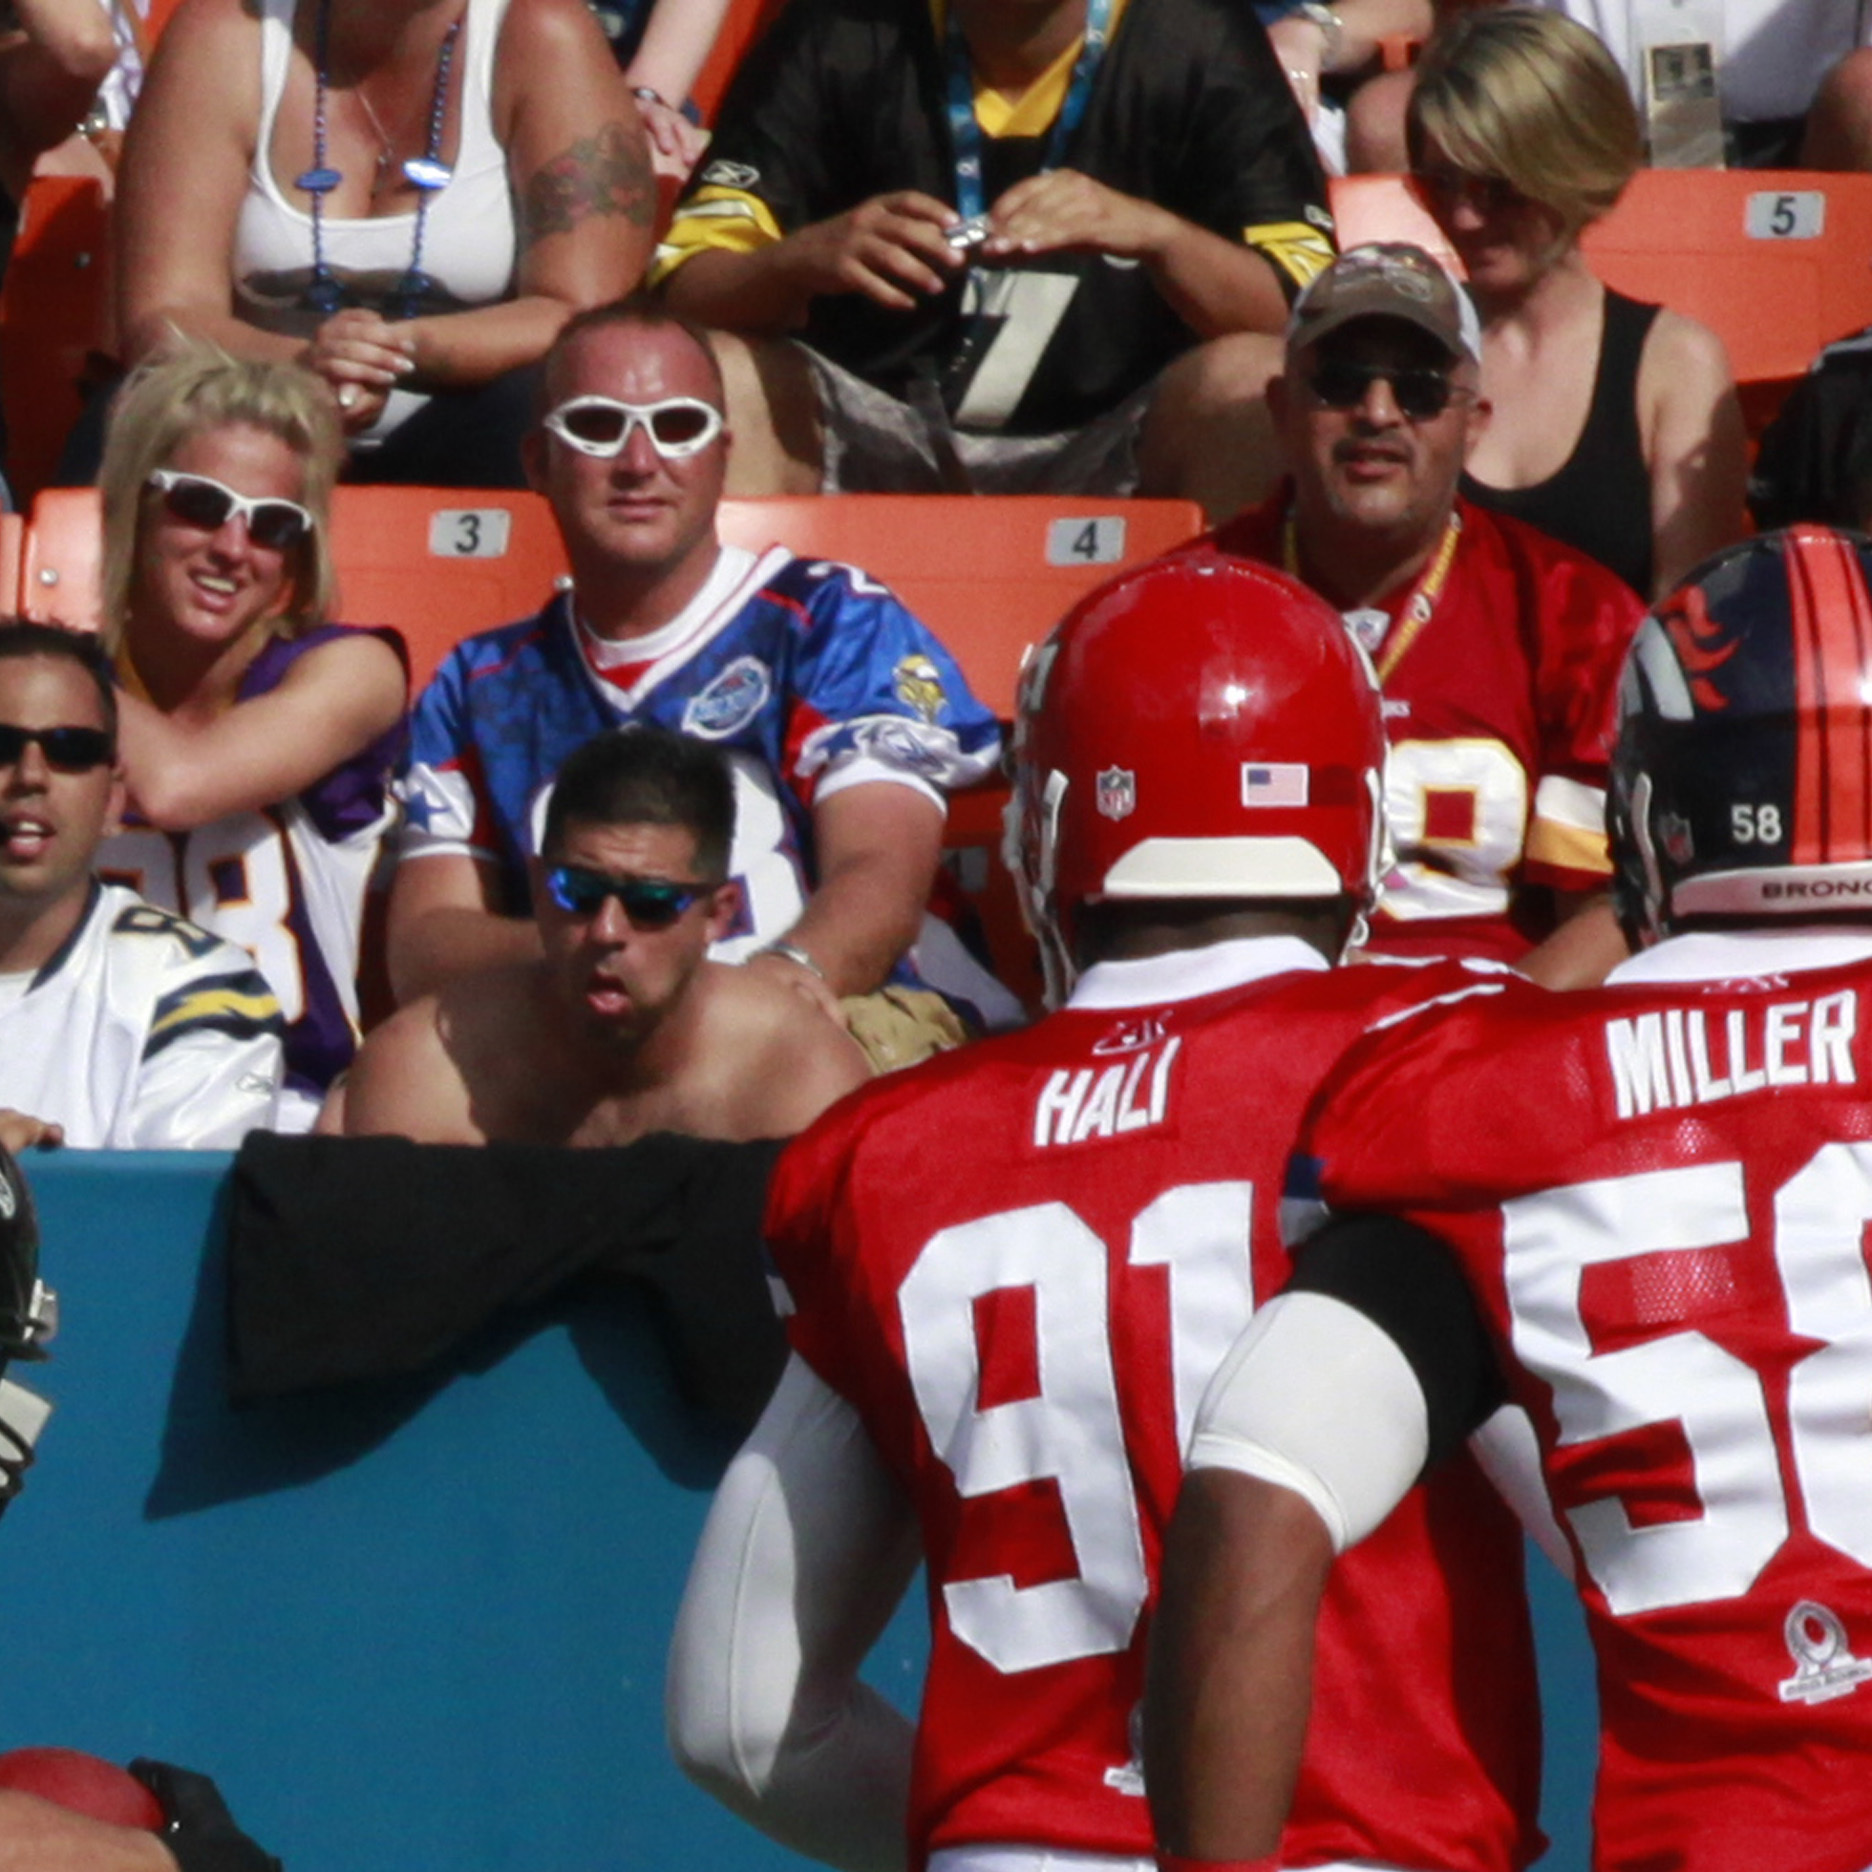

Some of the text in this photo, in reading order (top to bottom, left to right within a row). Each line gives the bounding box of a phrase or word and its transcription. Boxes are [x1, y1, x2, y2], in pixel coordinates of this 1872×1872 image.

[1770, 197, 1797, 237] 5
[955, 268, 1080, 426] 7
[455, 514, 482, 554] 3
[1072, 526, 1099, 561] 4
[1732, 804, 1782, 843] 58
[1034, 1035, 1183, 1148] HALI
[1606, 987, 1858, 1120] MILLER
[896, 1179, 1255, 1676] 91
